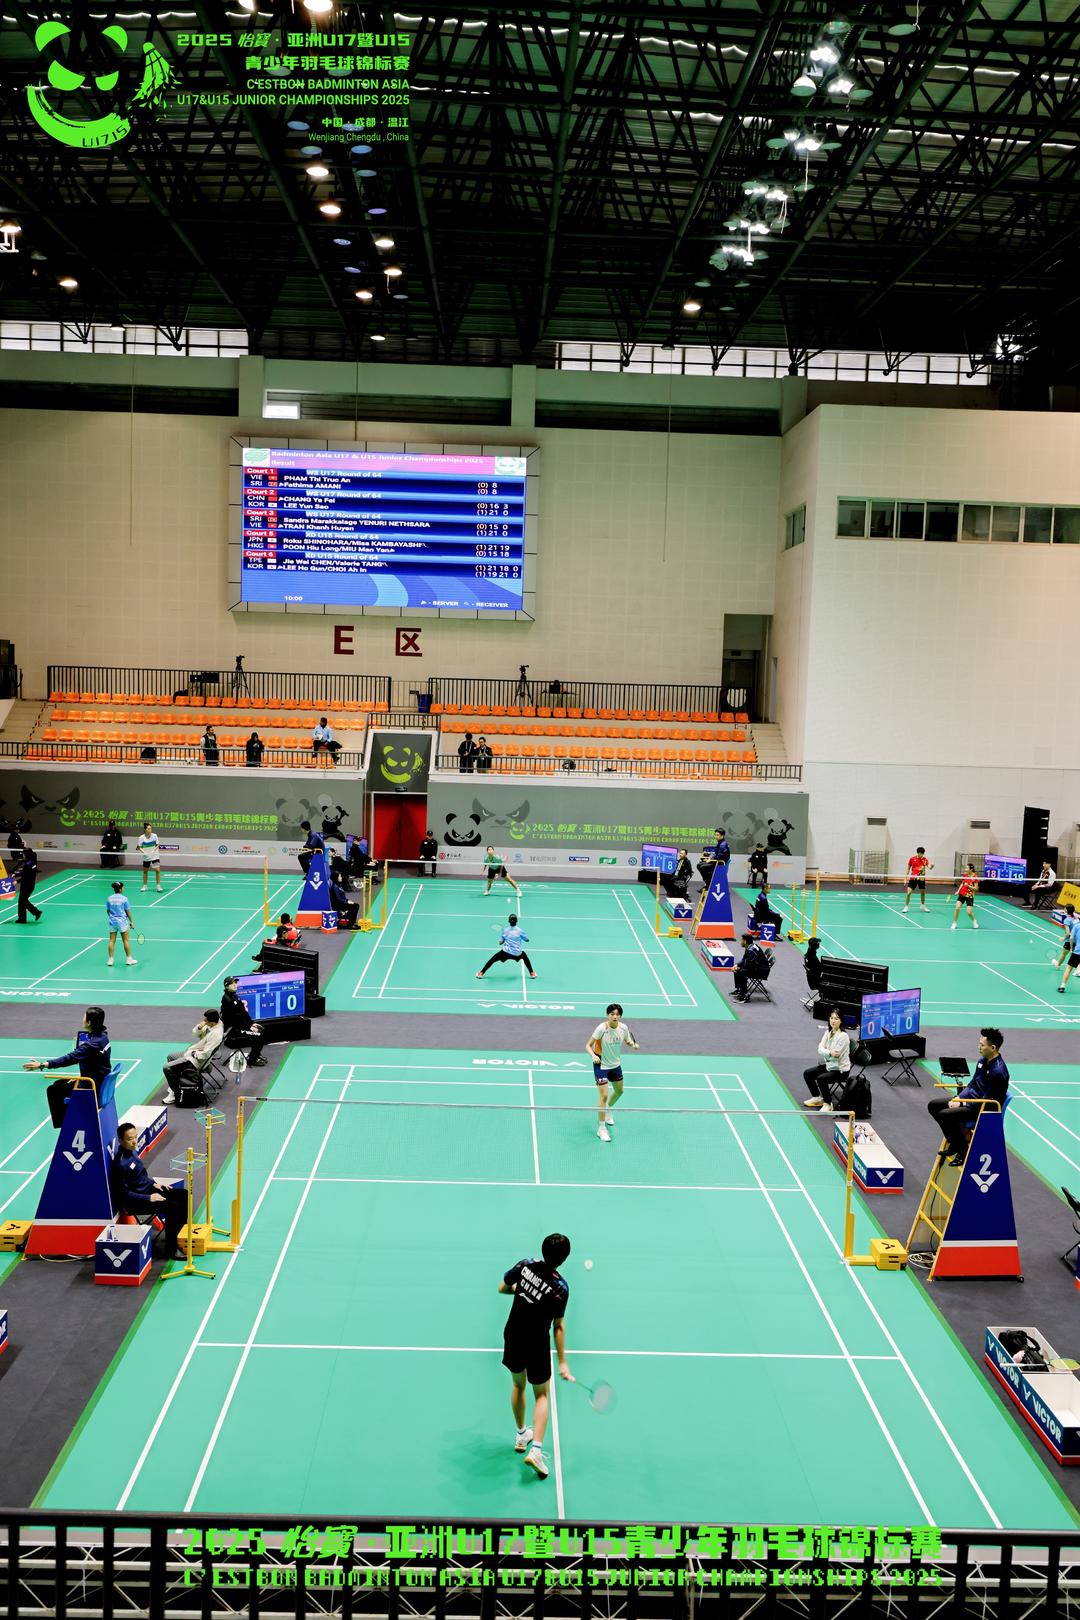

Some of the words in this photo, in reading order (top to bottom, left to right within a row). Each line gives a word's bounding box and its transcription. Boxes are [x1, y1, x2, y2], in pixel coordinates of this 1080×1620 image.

[334, 625, 354, 655] E
[395, 627, 422, 657] 区
[668, 860, 673, 870] 8
[314, 872, 320, 882] 3
[986, 870, 996, 878] 18
[715, 883, 720, 893] 1
[287, 994, 297, 1010] 0
[868, 1021, 874, 1035] 0
[906, 1016, 912, 1030] 0
[72, 1130, 85, 1152] 4
[979, 1154, 992, 1175] 2
[521, 1266, 542, 1287] CHANG
[520, 1279, 542, 1300] CHINA
[1033, 1395, 1061, 1443] VICTOR
